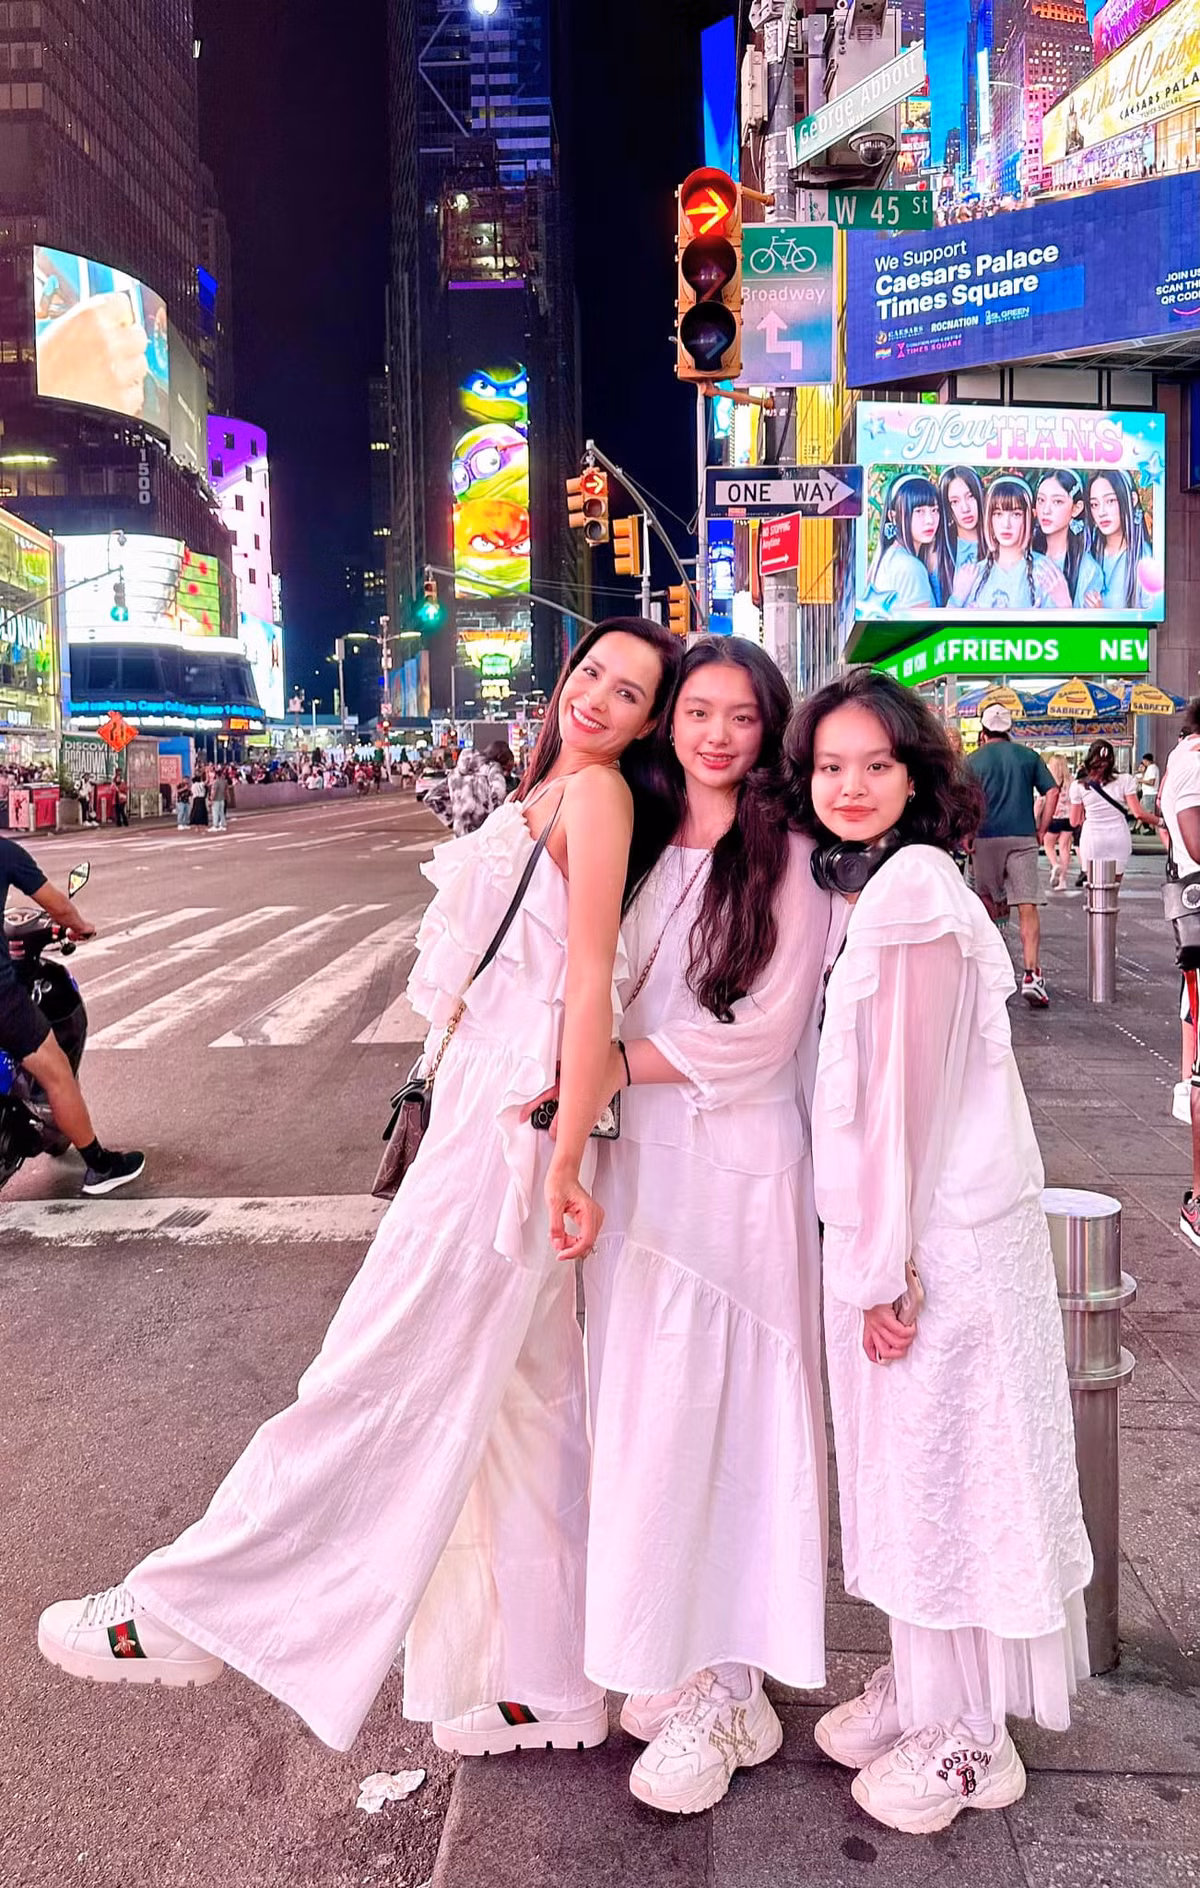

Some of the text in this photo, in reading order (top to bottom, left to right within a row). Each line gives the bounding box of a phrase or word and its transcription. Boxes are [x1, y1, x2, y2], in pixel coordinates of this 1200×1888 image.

[800, 54, 917, 145] George Abbott
[1119, 91, 1160, 120] CAESARS
[835, 195, 928, 225] W 45 St
[875, 240, 968, 273] We Support
[876, 245, 1060, 297] Caesars Palace
[1165, 271, 1189, 283] JOIN
[742, 287, 826, 304] Broadway
[876, 274, 1040, 321] Times Square
[1156, 283, 1184, 296] SCAN
[1161, 294, 1175, 305] QR
[931, 340, 962, 352] SQUARE
[138, 448, 151, 505] 1500
[728, 482, 839, 502] ONE WAY
[762, 520, 791, 538] NO STOPPING
[762, 537, 780, 550] Anytime
[17, 613, 47, 652] NAVY
[948, 639, 1059, 661] FRIENDS
[64, 740, 112, 752] DISCOV
[936, 1749, 992, 1781] BOSTON
